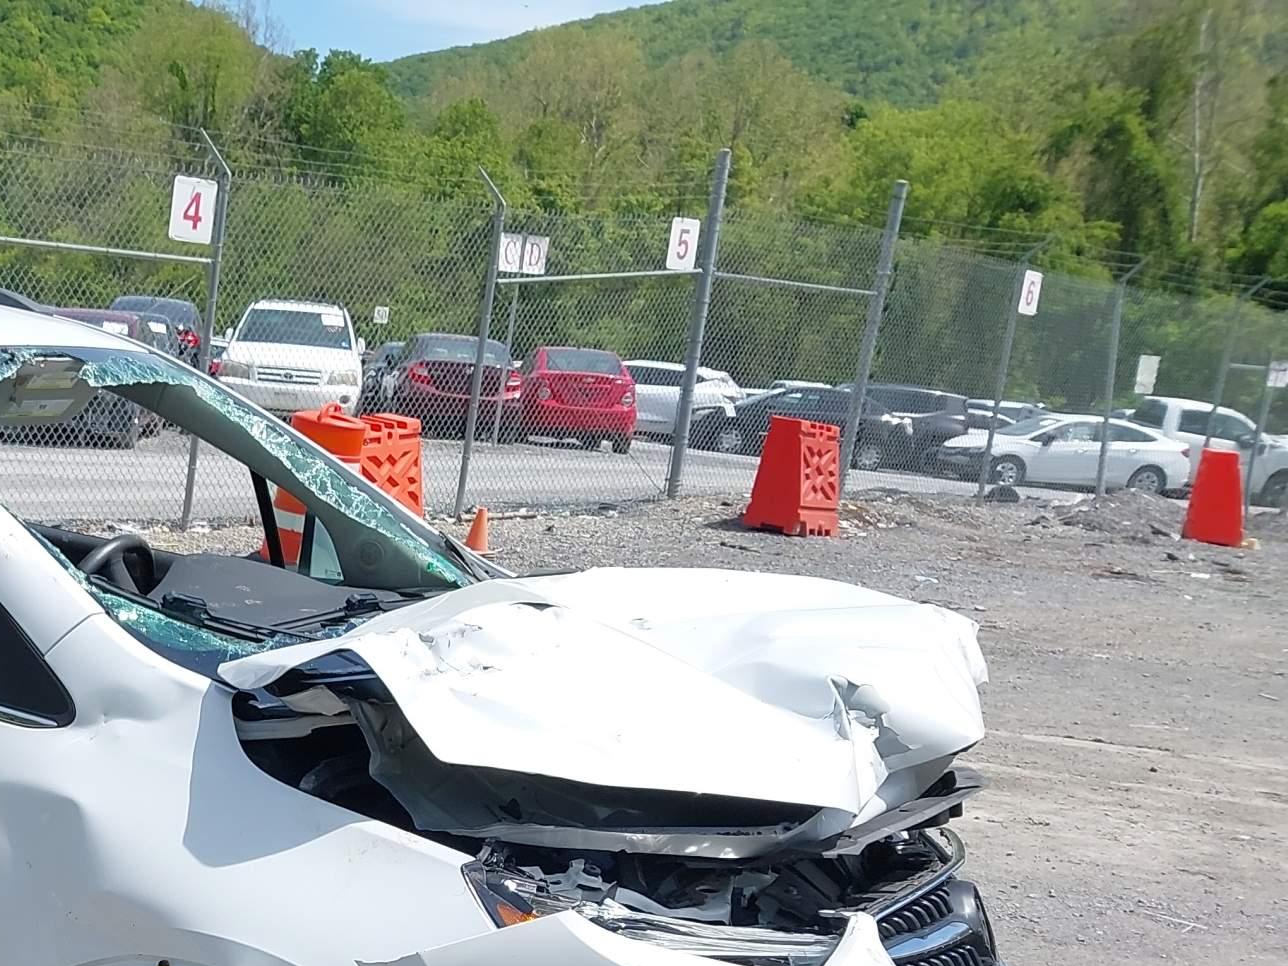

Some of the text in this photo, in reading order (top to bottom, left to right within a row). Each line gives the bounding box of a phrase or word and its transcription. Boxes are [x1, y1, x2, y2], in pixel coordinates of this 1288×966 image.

[183, 192, 202, 230] 4
[504, 240, 517, 265] C
[528, 242, 542, 267] D
[676, 229, 689, 260] 5
[1025, 281, 1034, 306] 6
